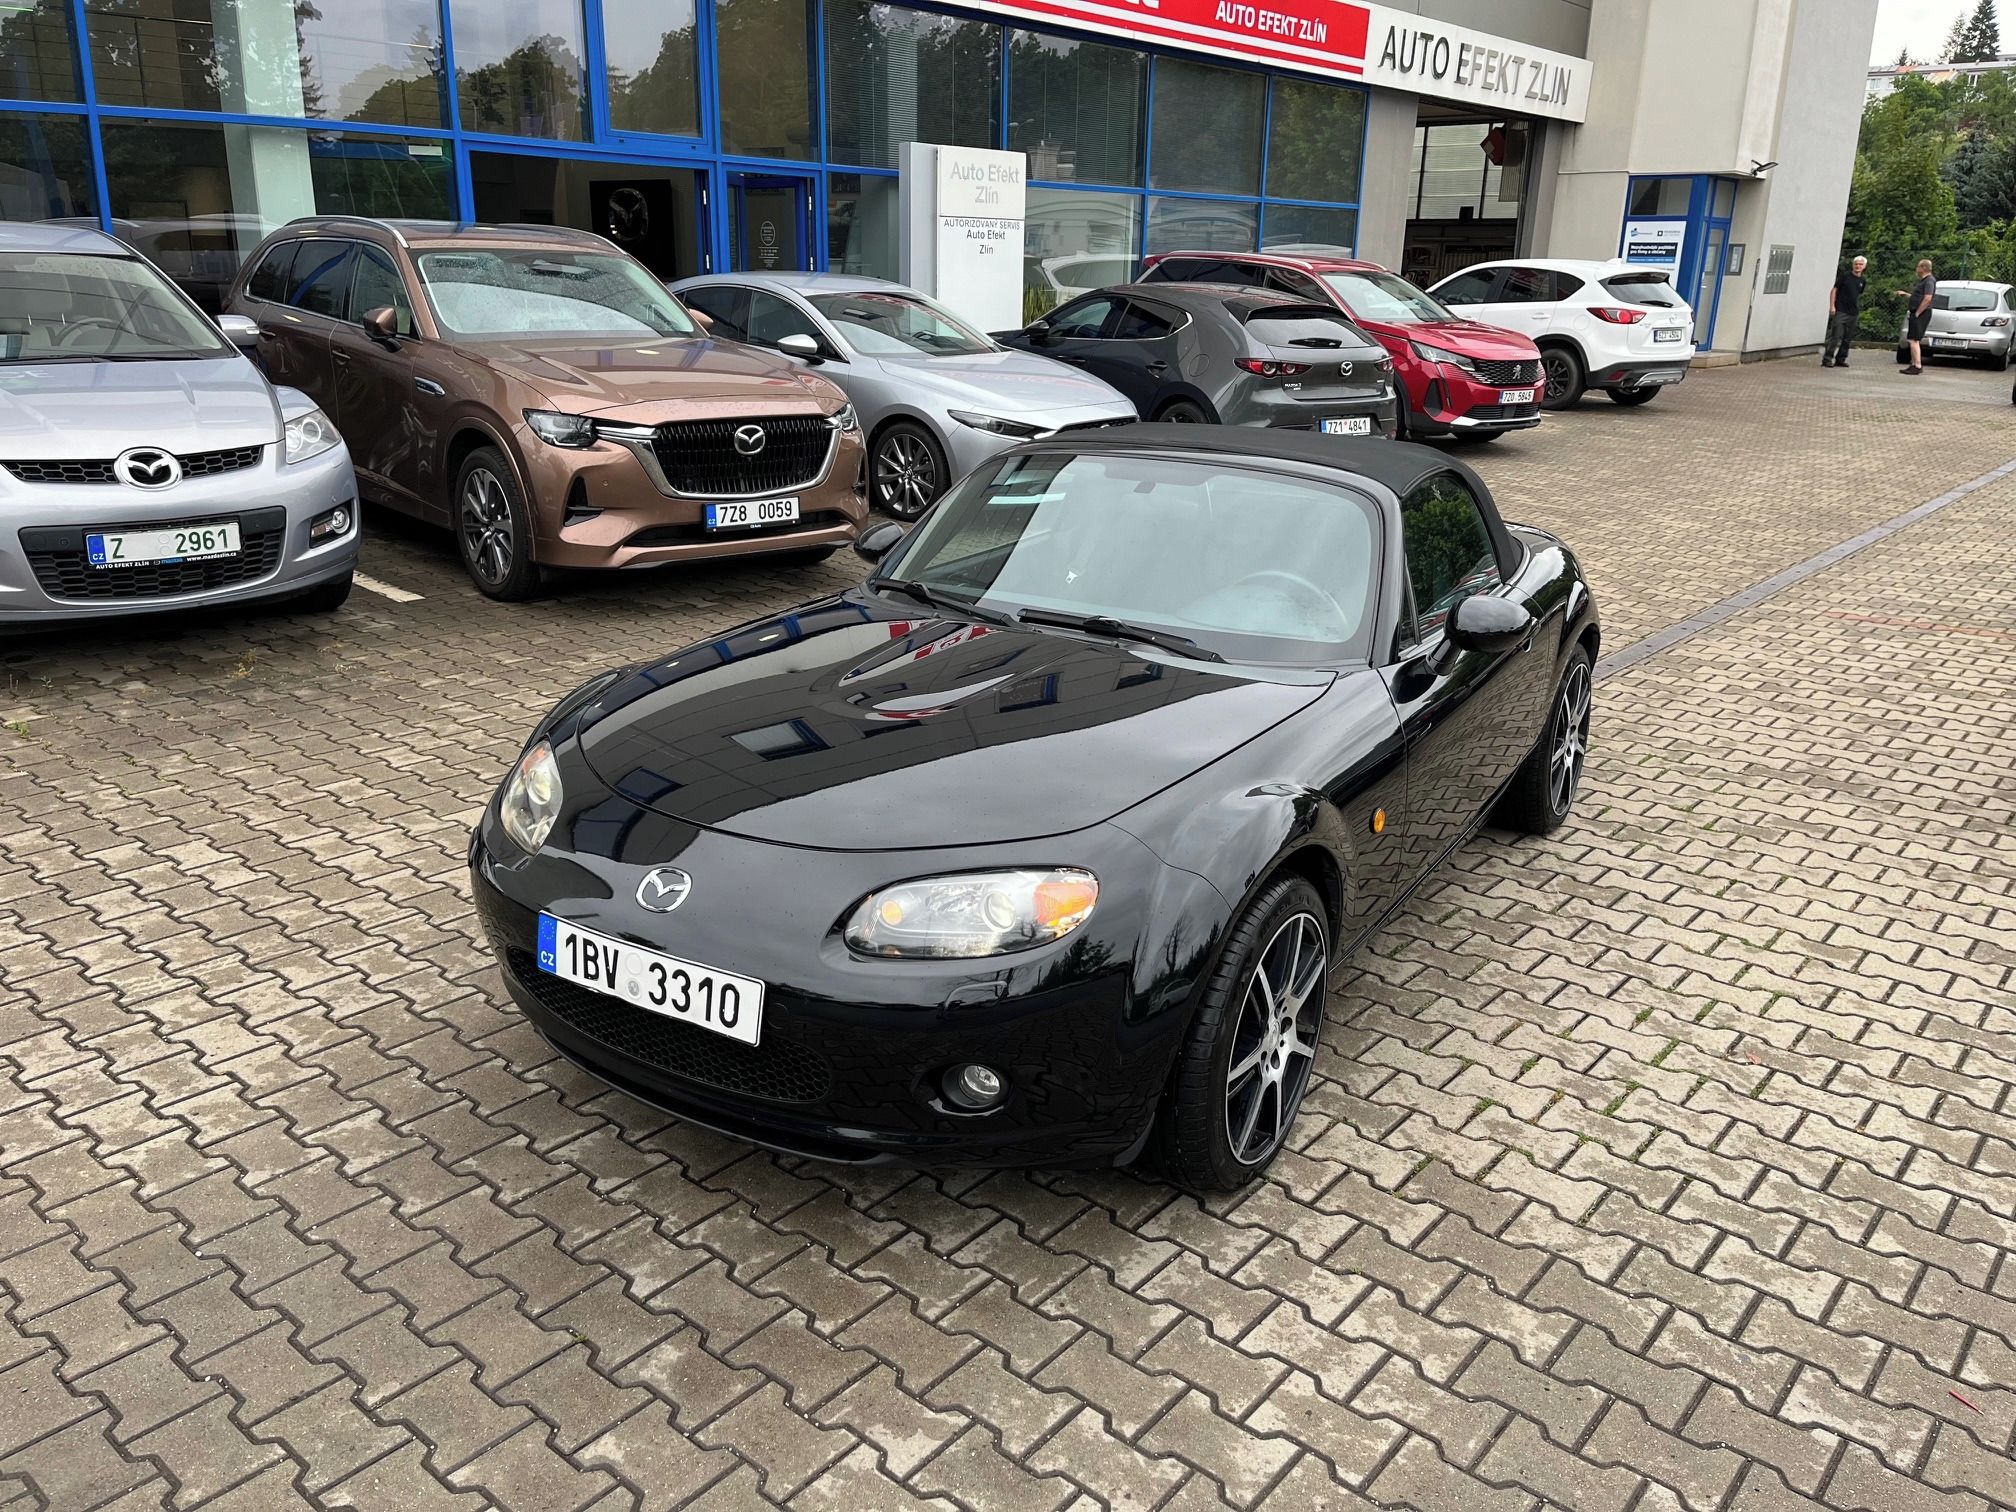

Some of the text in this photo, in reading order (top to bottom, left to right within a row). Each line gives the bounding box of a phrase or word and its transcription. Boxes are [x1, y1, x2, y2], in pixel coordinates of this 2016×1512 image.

[1215, 1, 1328, 44] AUTO EFEKT ZLÍN
[1378, 25, 1572, 105] AUTO EFEKT ZLIN
[950, 161, 1020, 184] Auto Efekt
[975, 186, 999, 204] Zlín
[944, 218, 1021, 230] AUTORIZOVANÝ SERVIS
[966, 229, 1006, 240] Auto Efekt
[979, 244, 994, 254] Zlín
[1328, 419, 1367, 434] 7Z1 4841
[720, 500, 792, 524] 7Z8 0059
[110, 528, 229, 559] Z 2961
[92, 553, 105, 561] CZ
[96, 562, 113, 570] AUTO
[114, 561, 133, 569] EFEKT
[187, 551, 237, 562] www.mazdazlin.cz
[540, 950, 555, 967] CZ
[565, 933, 740, 1029] 1BV 3310
